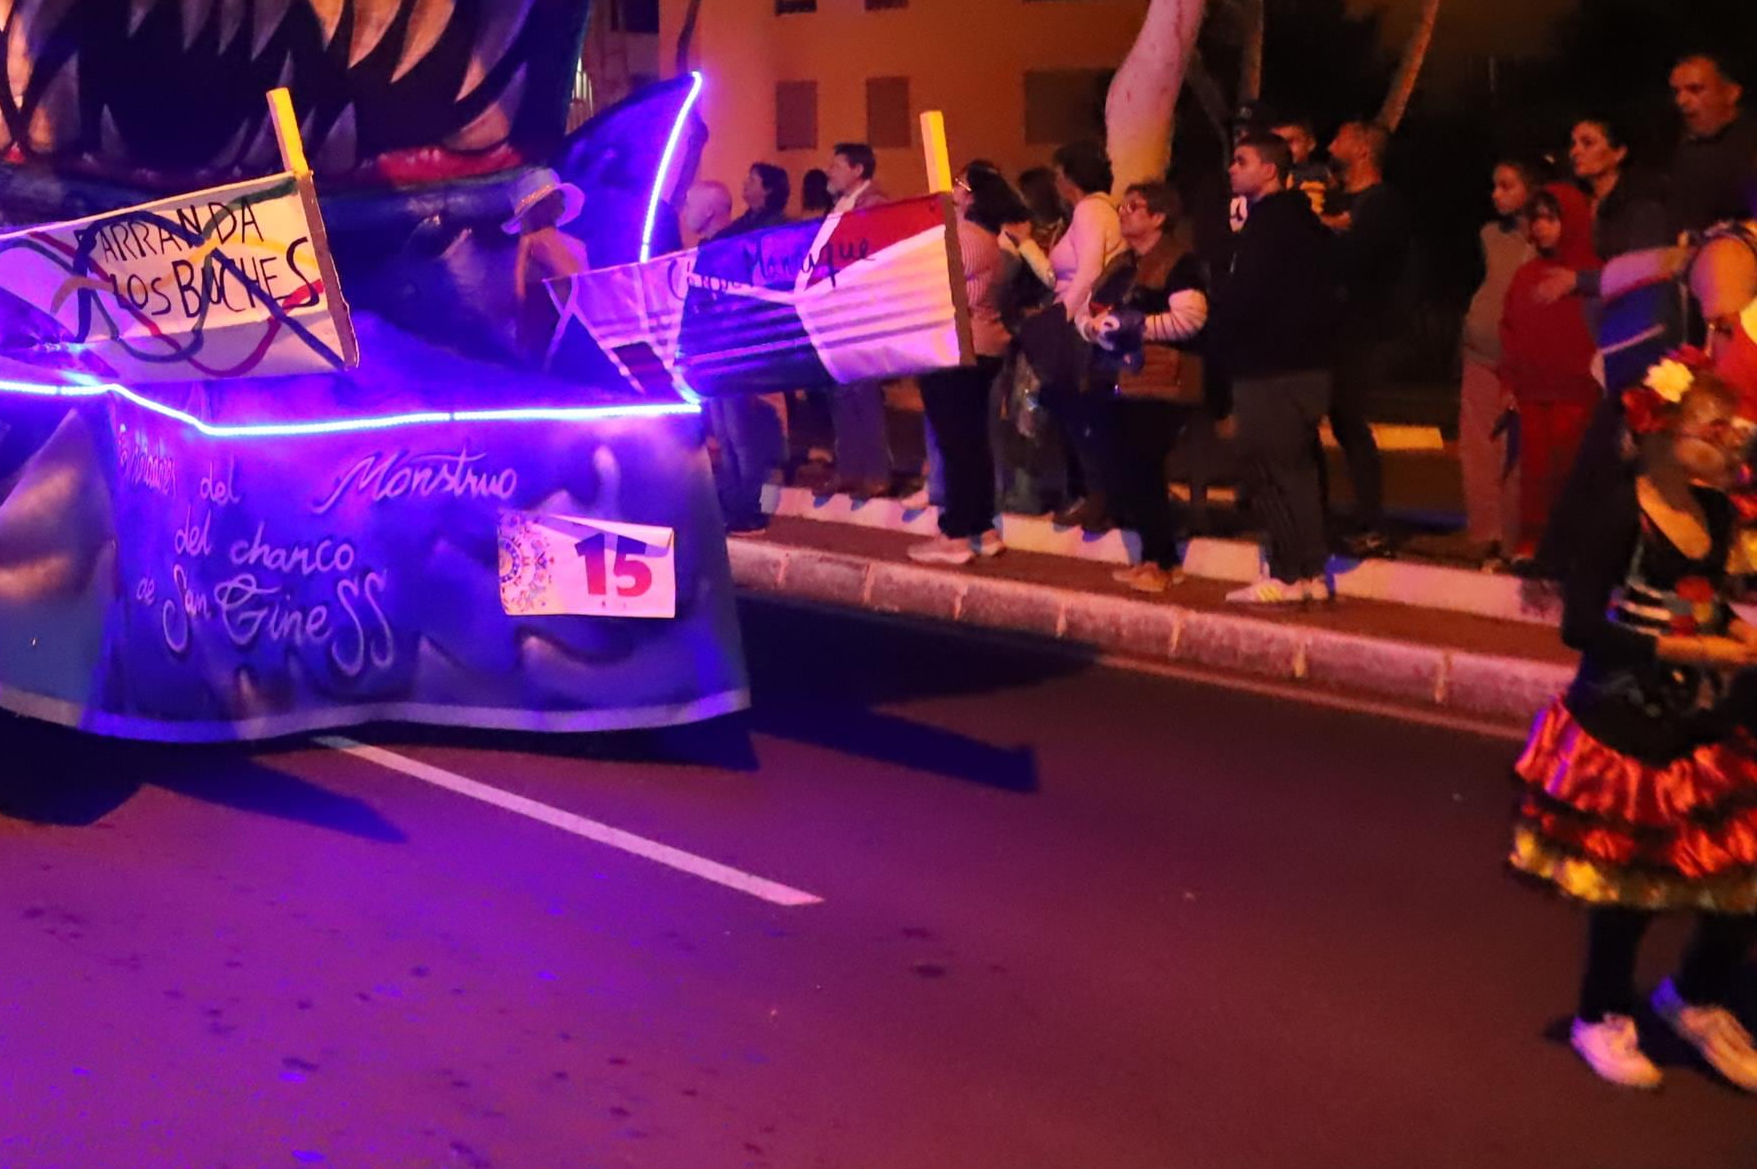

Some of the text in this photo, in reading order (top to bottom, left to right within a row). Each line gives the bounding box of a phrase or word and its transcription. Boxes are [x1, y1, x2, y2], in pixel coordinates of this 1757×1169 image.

[199, 452, 240, 504] del
[309, 442, 518, 515] Monstruo
[174, 503, 212, 557] del
[573, 531, 653, 598] 15
[135, 575, 156, 606] de
[162, 563, 211, 653] San
